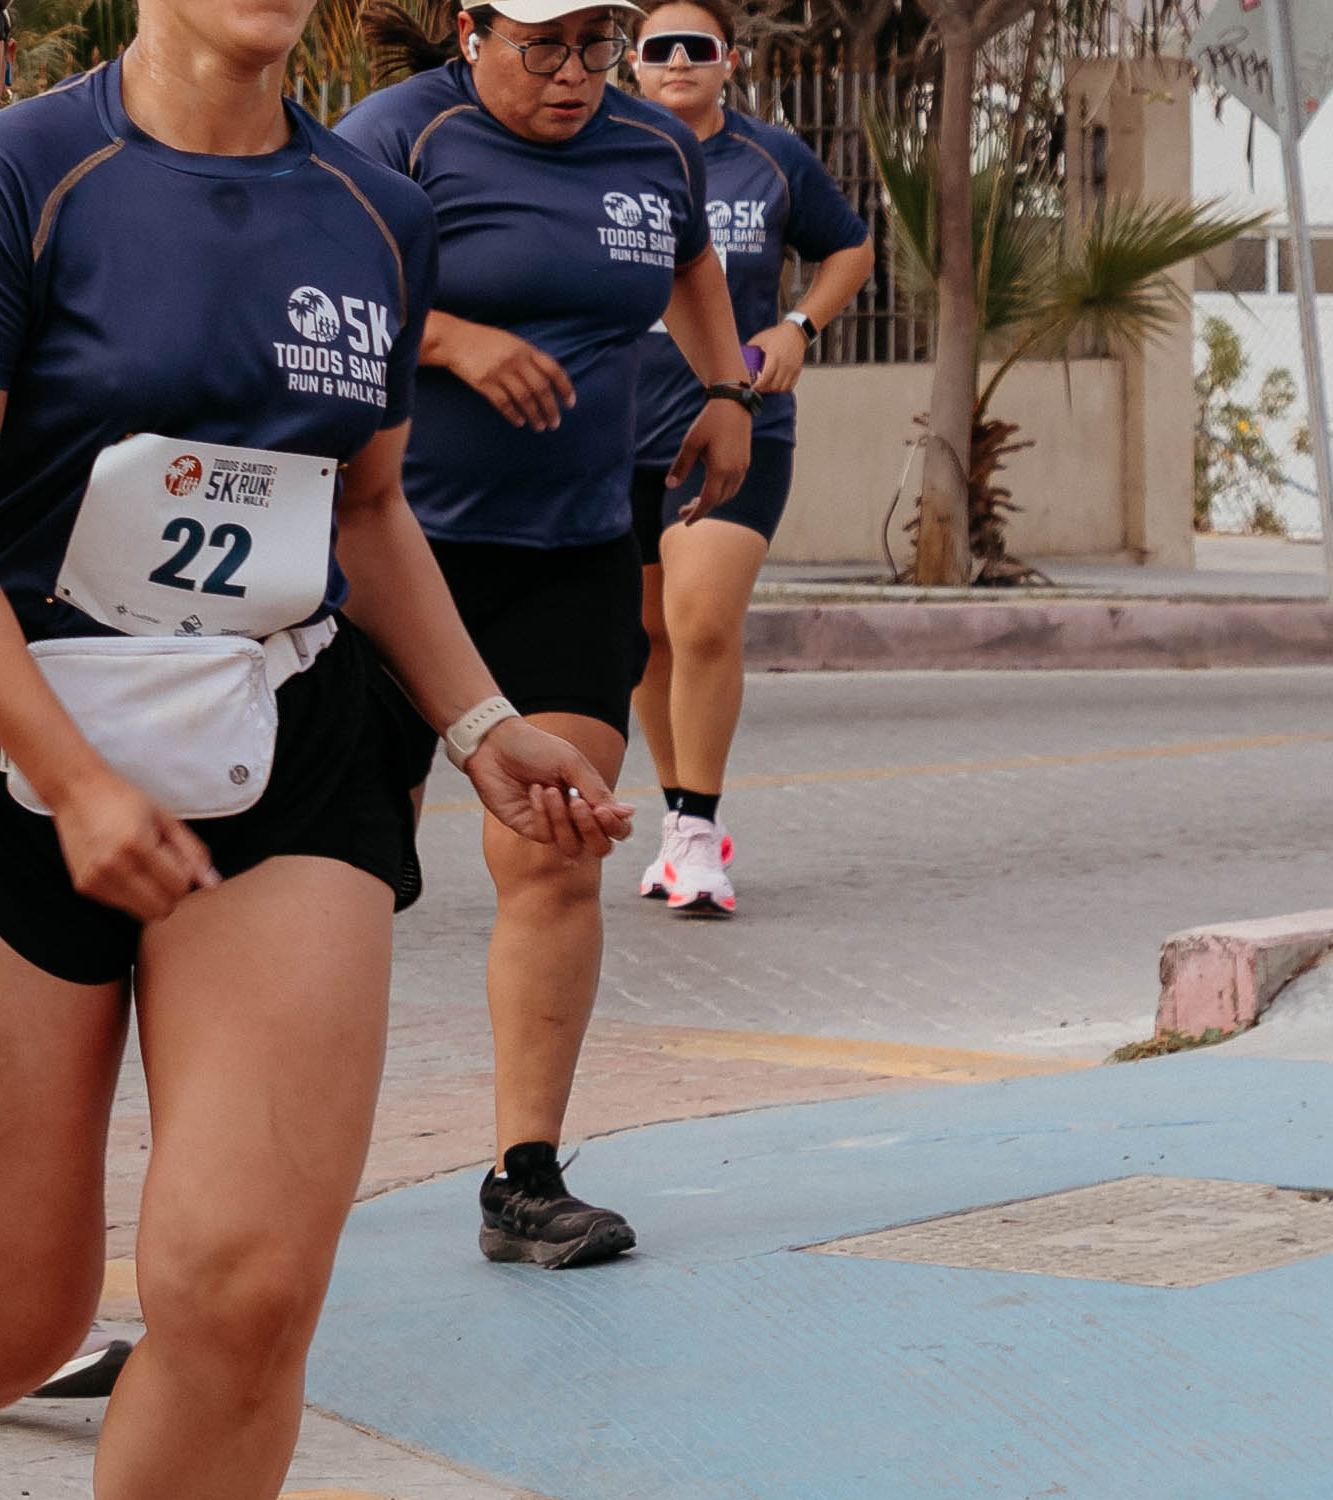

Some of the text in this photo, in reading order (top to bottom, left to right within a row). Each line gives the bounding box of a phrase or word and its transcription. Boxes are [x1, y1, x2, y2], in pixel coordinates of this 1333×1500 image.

[639, 193, 673, 232] 5K
[734, 200, 766, 228] 5K
[597, 227, 646, 249] TODOS
[610, 247, 632, 261] RUN
[341, 295, 393, 357] 5K
[273, 342, 344, 375] TODOS
[288, 373, 319, 393] RUN
[322, 377, 334, 395] &
[336, 379, 374, 404] WALK
[213, 458, 273, 476] TODOS SANTOS
[205, 471, 270, 503] 5K RUN
[148, 517, 253, 599] 22
